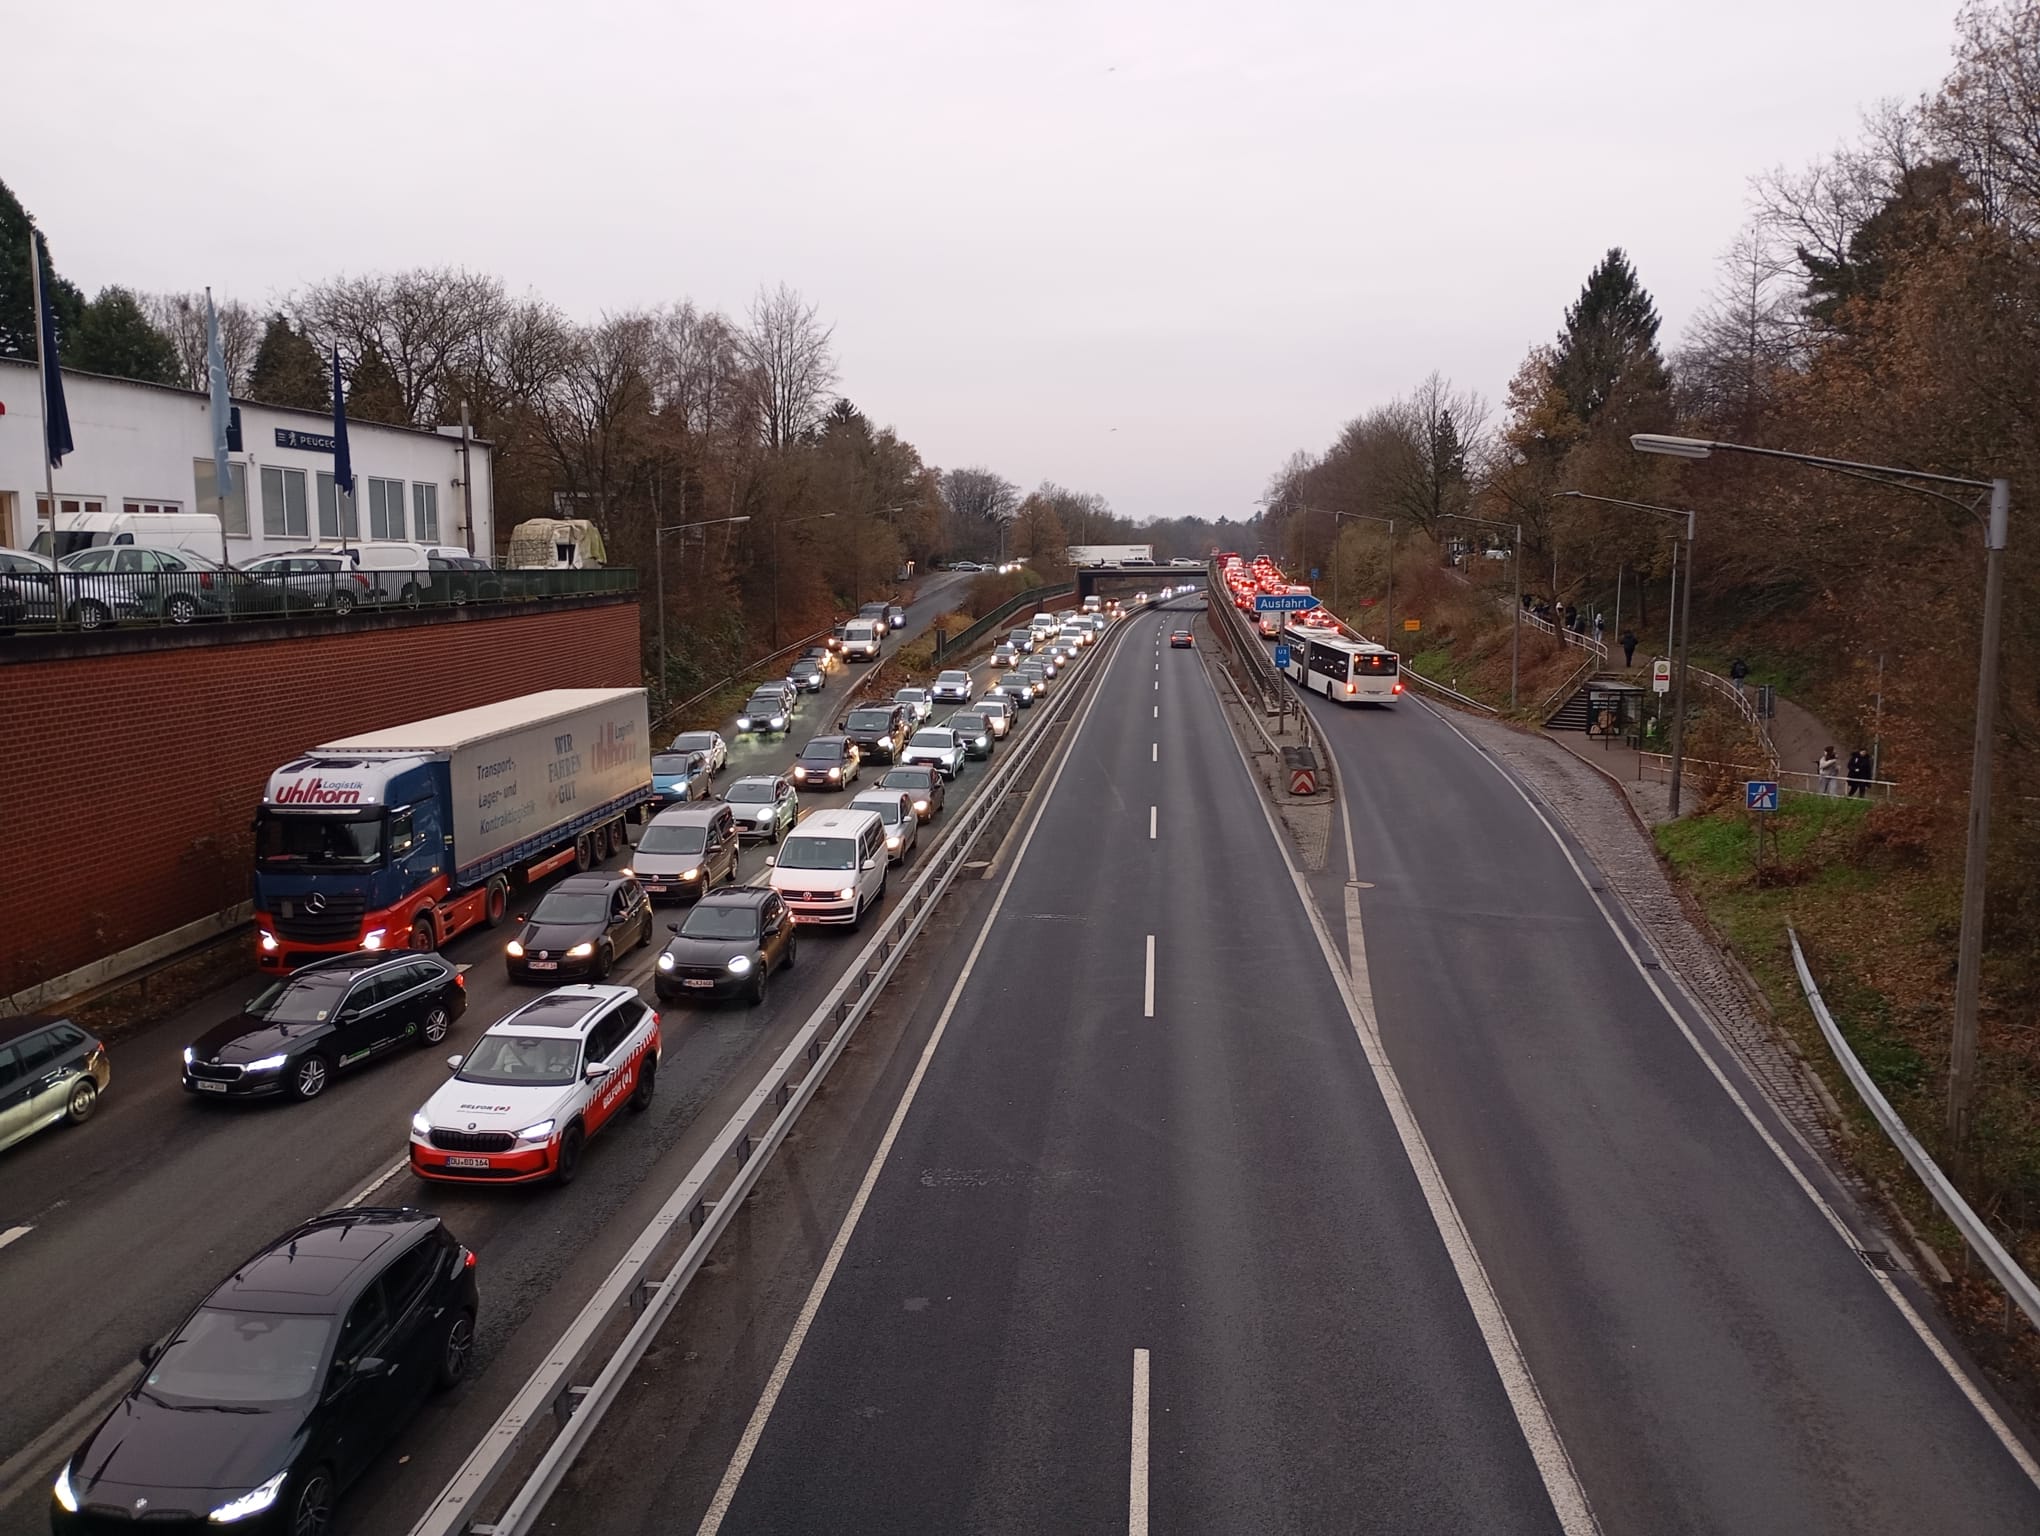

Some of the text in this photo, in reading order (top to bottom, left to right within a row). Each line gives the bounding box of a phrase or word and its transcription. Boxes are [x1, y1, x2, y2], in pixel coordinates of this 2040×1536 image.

[300, 436, 336, 448] PEUGEO
[1260, 599, 1307, 608] Ausfahrt
[555, 734, 573, 754] WIR
[275, 778, 360, 804] uhlhorn
[323, 781, 364, 790] Logistik
[504, 780, 517, 798] und
[558, 780, 576, 804] GUT
[602, 1080, 622, 1110] BELFOR
